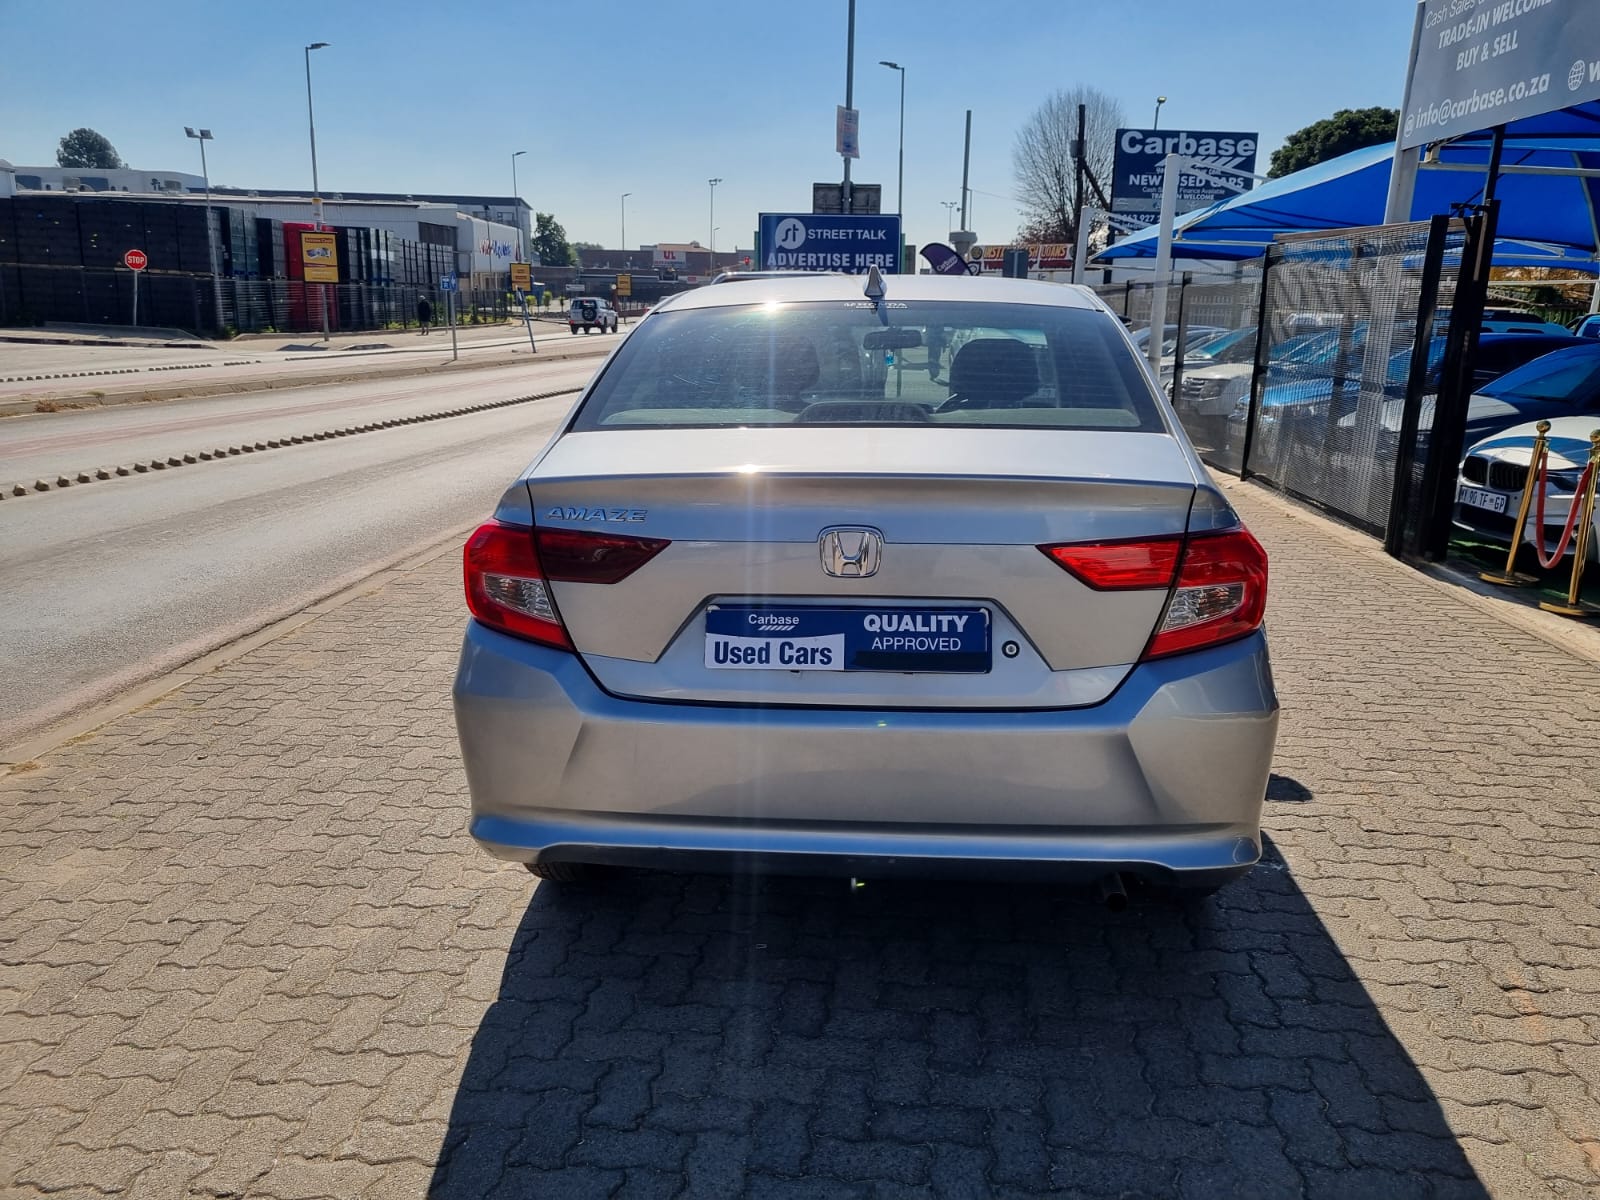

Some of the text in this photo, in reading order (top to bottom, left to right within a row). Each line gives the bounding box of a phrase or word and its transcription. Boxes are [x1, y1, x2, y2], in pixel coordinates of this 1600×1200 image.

[1425, 5, 1447, 29] Cash
[1438, 11, 1490, 49] TRADE-IN
[1456, 29, 1518, 71] BUY & SELL
[1415, 73, 1551, 129] info@carbase.co.za
[1121, 131, 1256, 156] Carbase
[1129, 174, 1162, 186] NEW
[807, 229, 886, 240] STREET TALK
[127, 255, 145, 265] STOP
[767, 253, 894, 267] ADVERTISE HERE
[1494, 496, 1505, 512] GP
[548, 506, 648, 522] AMAZE
[748, 613, 800, 625] Carbase
[863, 614, 969, 633] QUALITY
[871, 637, 962, 651] APPROVED
[714, 641, 833, 665] Used Cars
